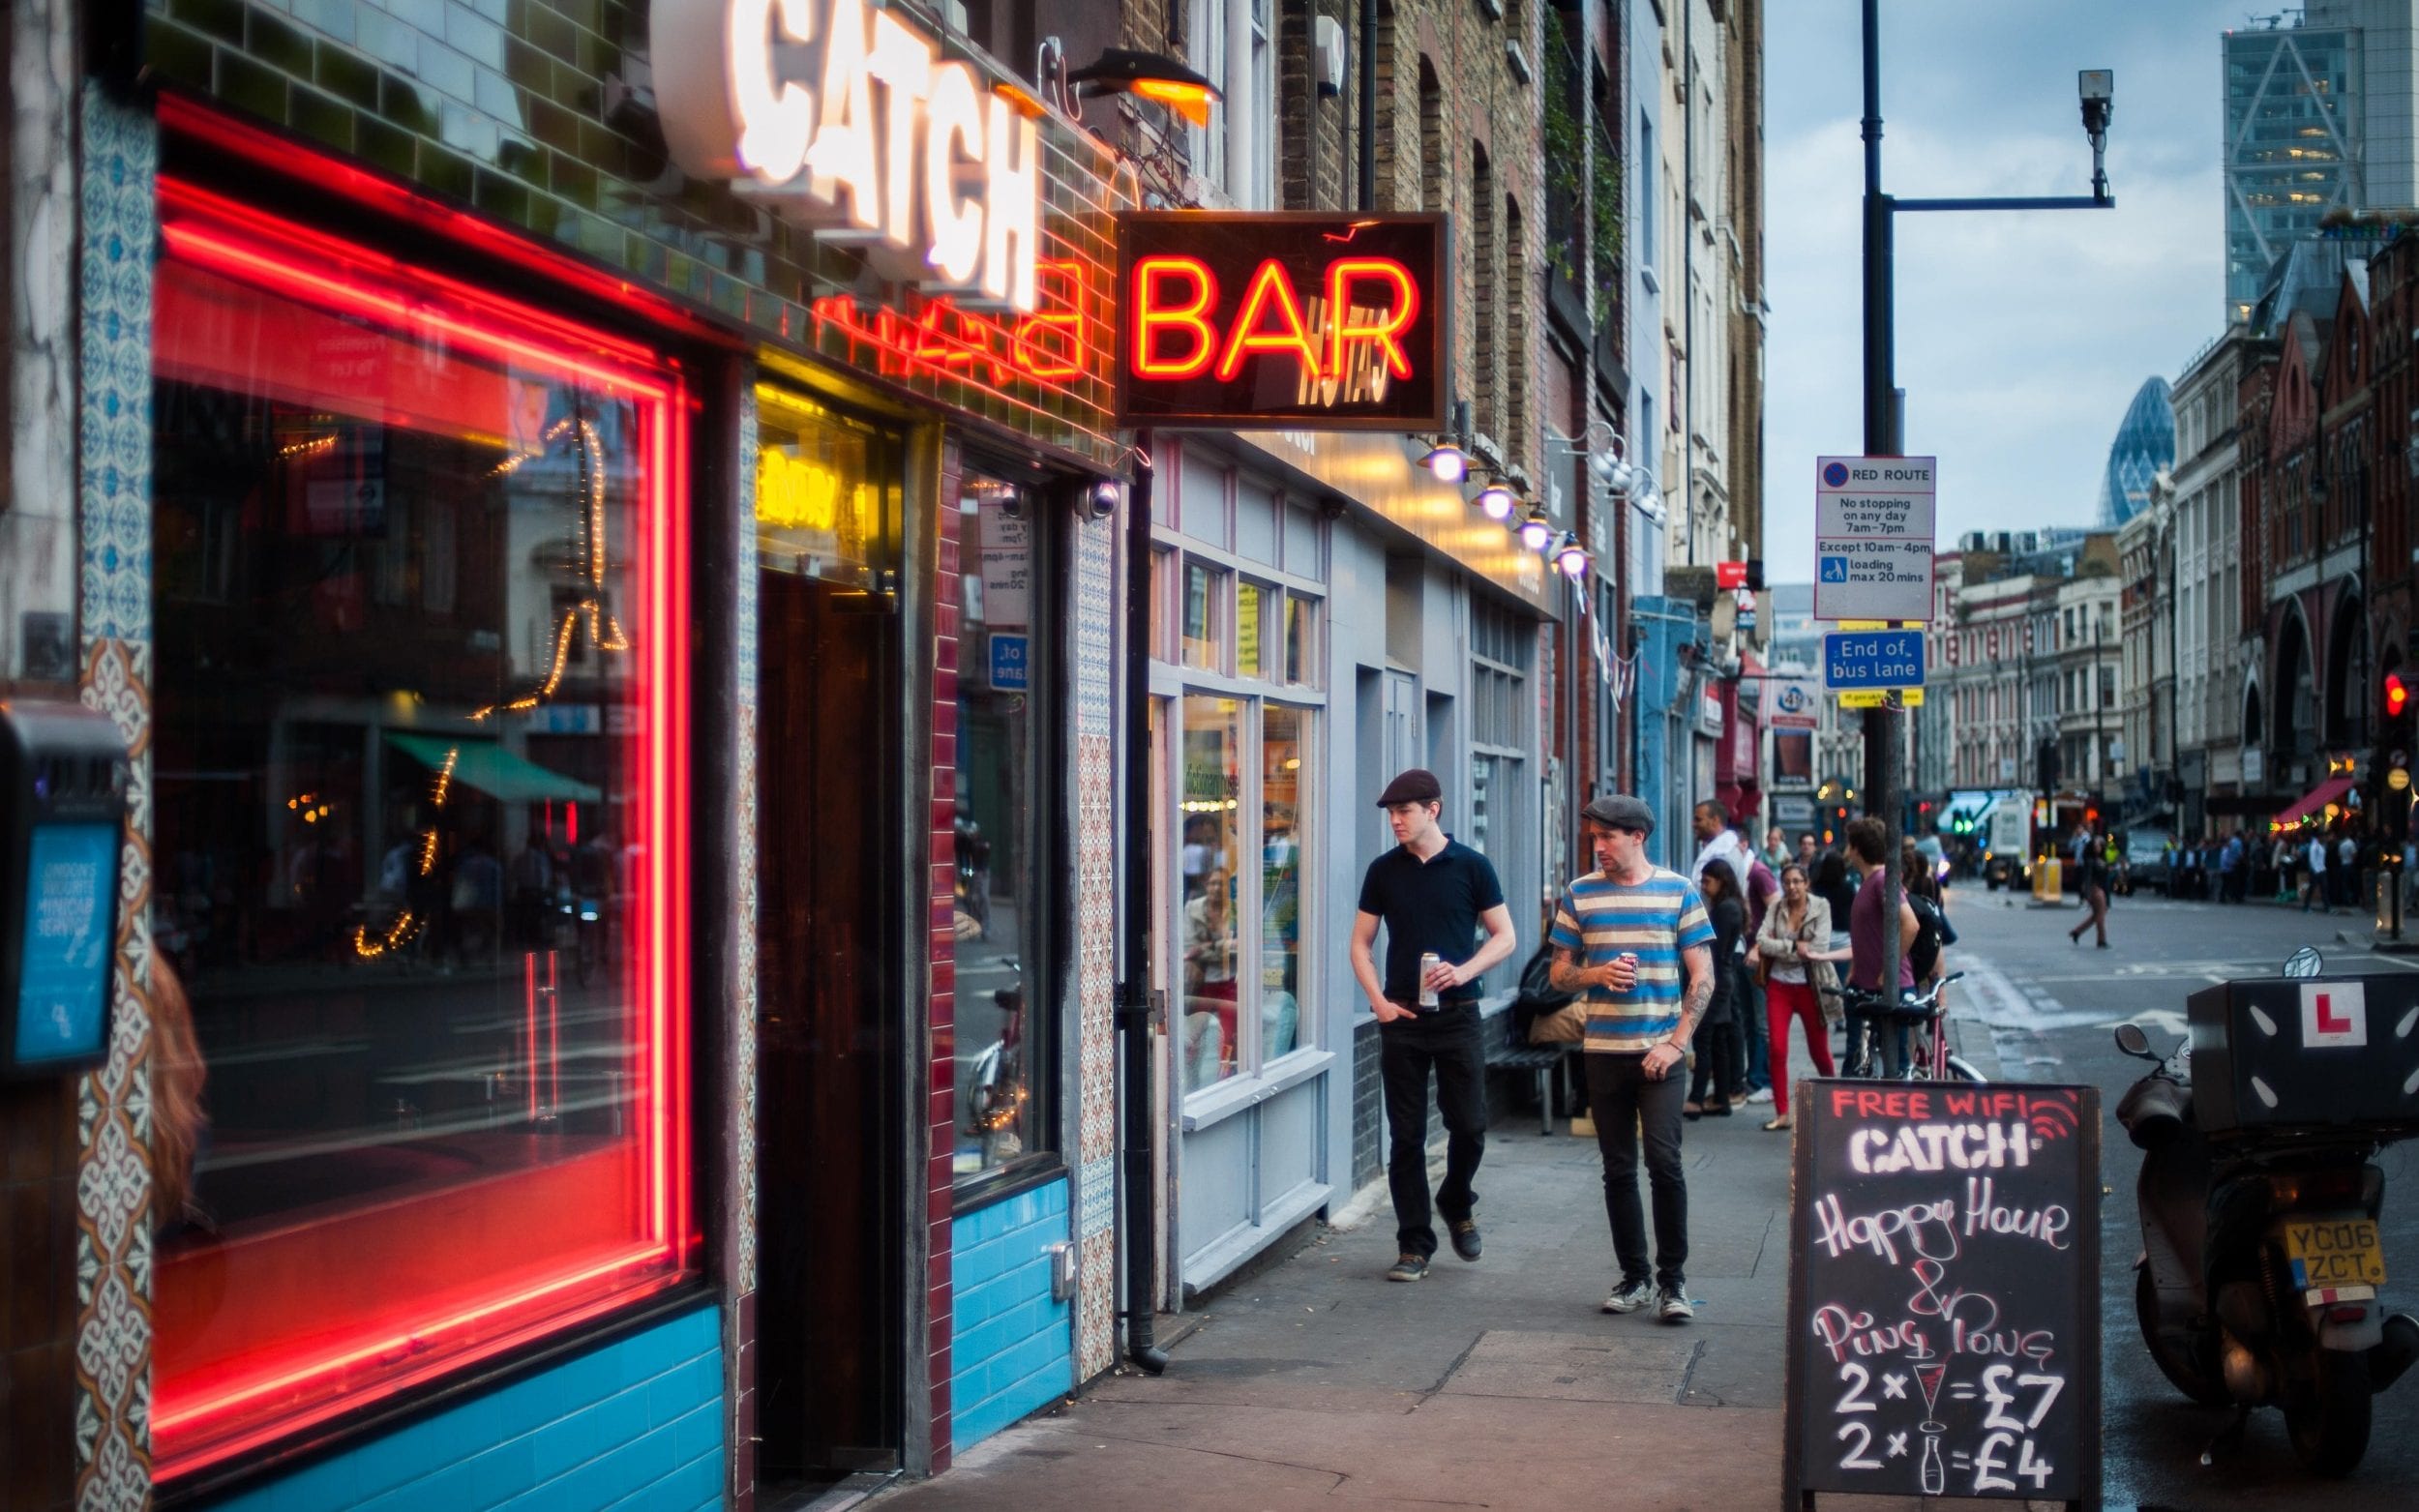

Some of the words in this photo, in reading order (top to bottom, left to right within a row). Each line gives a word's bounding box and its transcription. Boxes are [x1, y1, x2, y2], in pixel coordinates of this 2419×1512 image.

[728, 0, 1037, 314] CATCH
[1132, 255, 1420, 382] BAR
[1851, 469, 1879, 481] RED
[1884, 469, 1930, 481] ROUTE
[1839, 497, 1857, 509] No
[1860, 498, 1911, 511] stopping
[1843, 512, 1858, 521] on
[1860, 512, 1881, 522] any
[1885, 511, 1907, 522] day
[1819, 542, 1862, 553] Except
[1850, 559, 1894, 571] loading
[1850, 573, 1875, 582] max
[1878, 572, 1896, 582] 20
[1897, 572, 1924, 582] mins
[1840, 639, 1878, 658] End
[1886, 638, 1907, 657] of
[1832, 661, 1867, 679] bus
[1874, 660, 1917, 678] lane
[2315, 993, 2352, 1034] L
[1831, 1090, 1932, 1120] FREE
[1850, 1122, 2030, 1173] CATCH
[1814, 1193, 1961, 1265] Happy
[2307, 1254, 2367, 1280] ZCT
[1836, 1362, 1878, 1413] 2
[1837, 1421, 1885, 1469] 2
